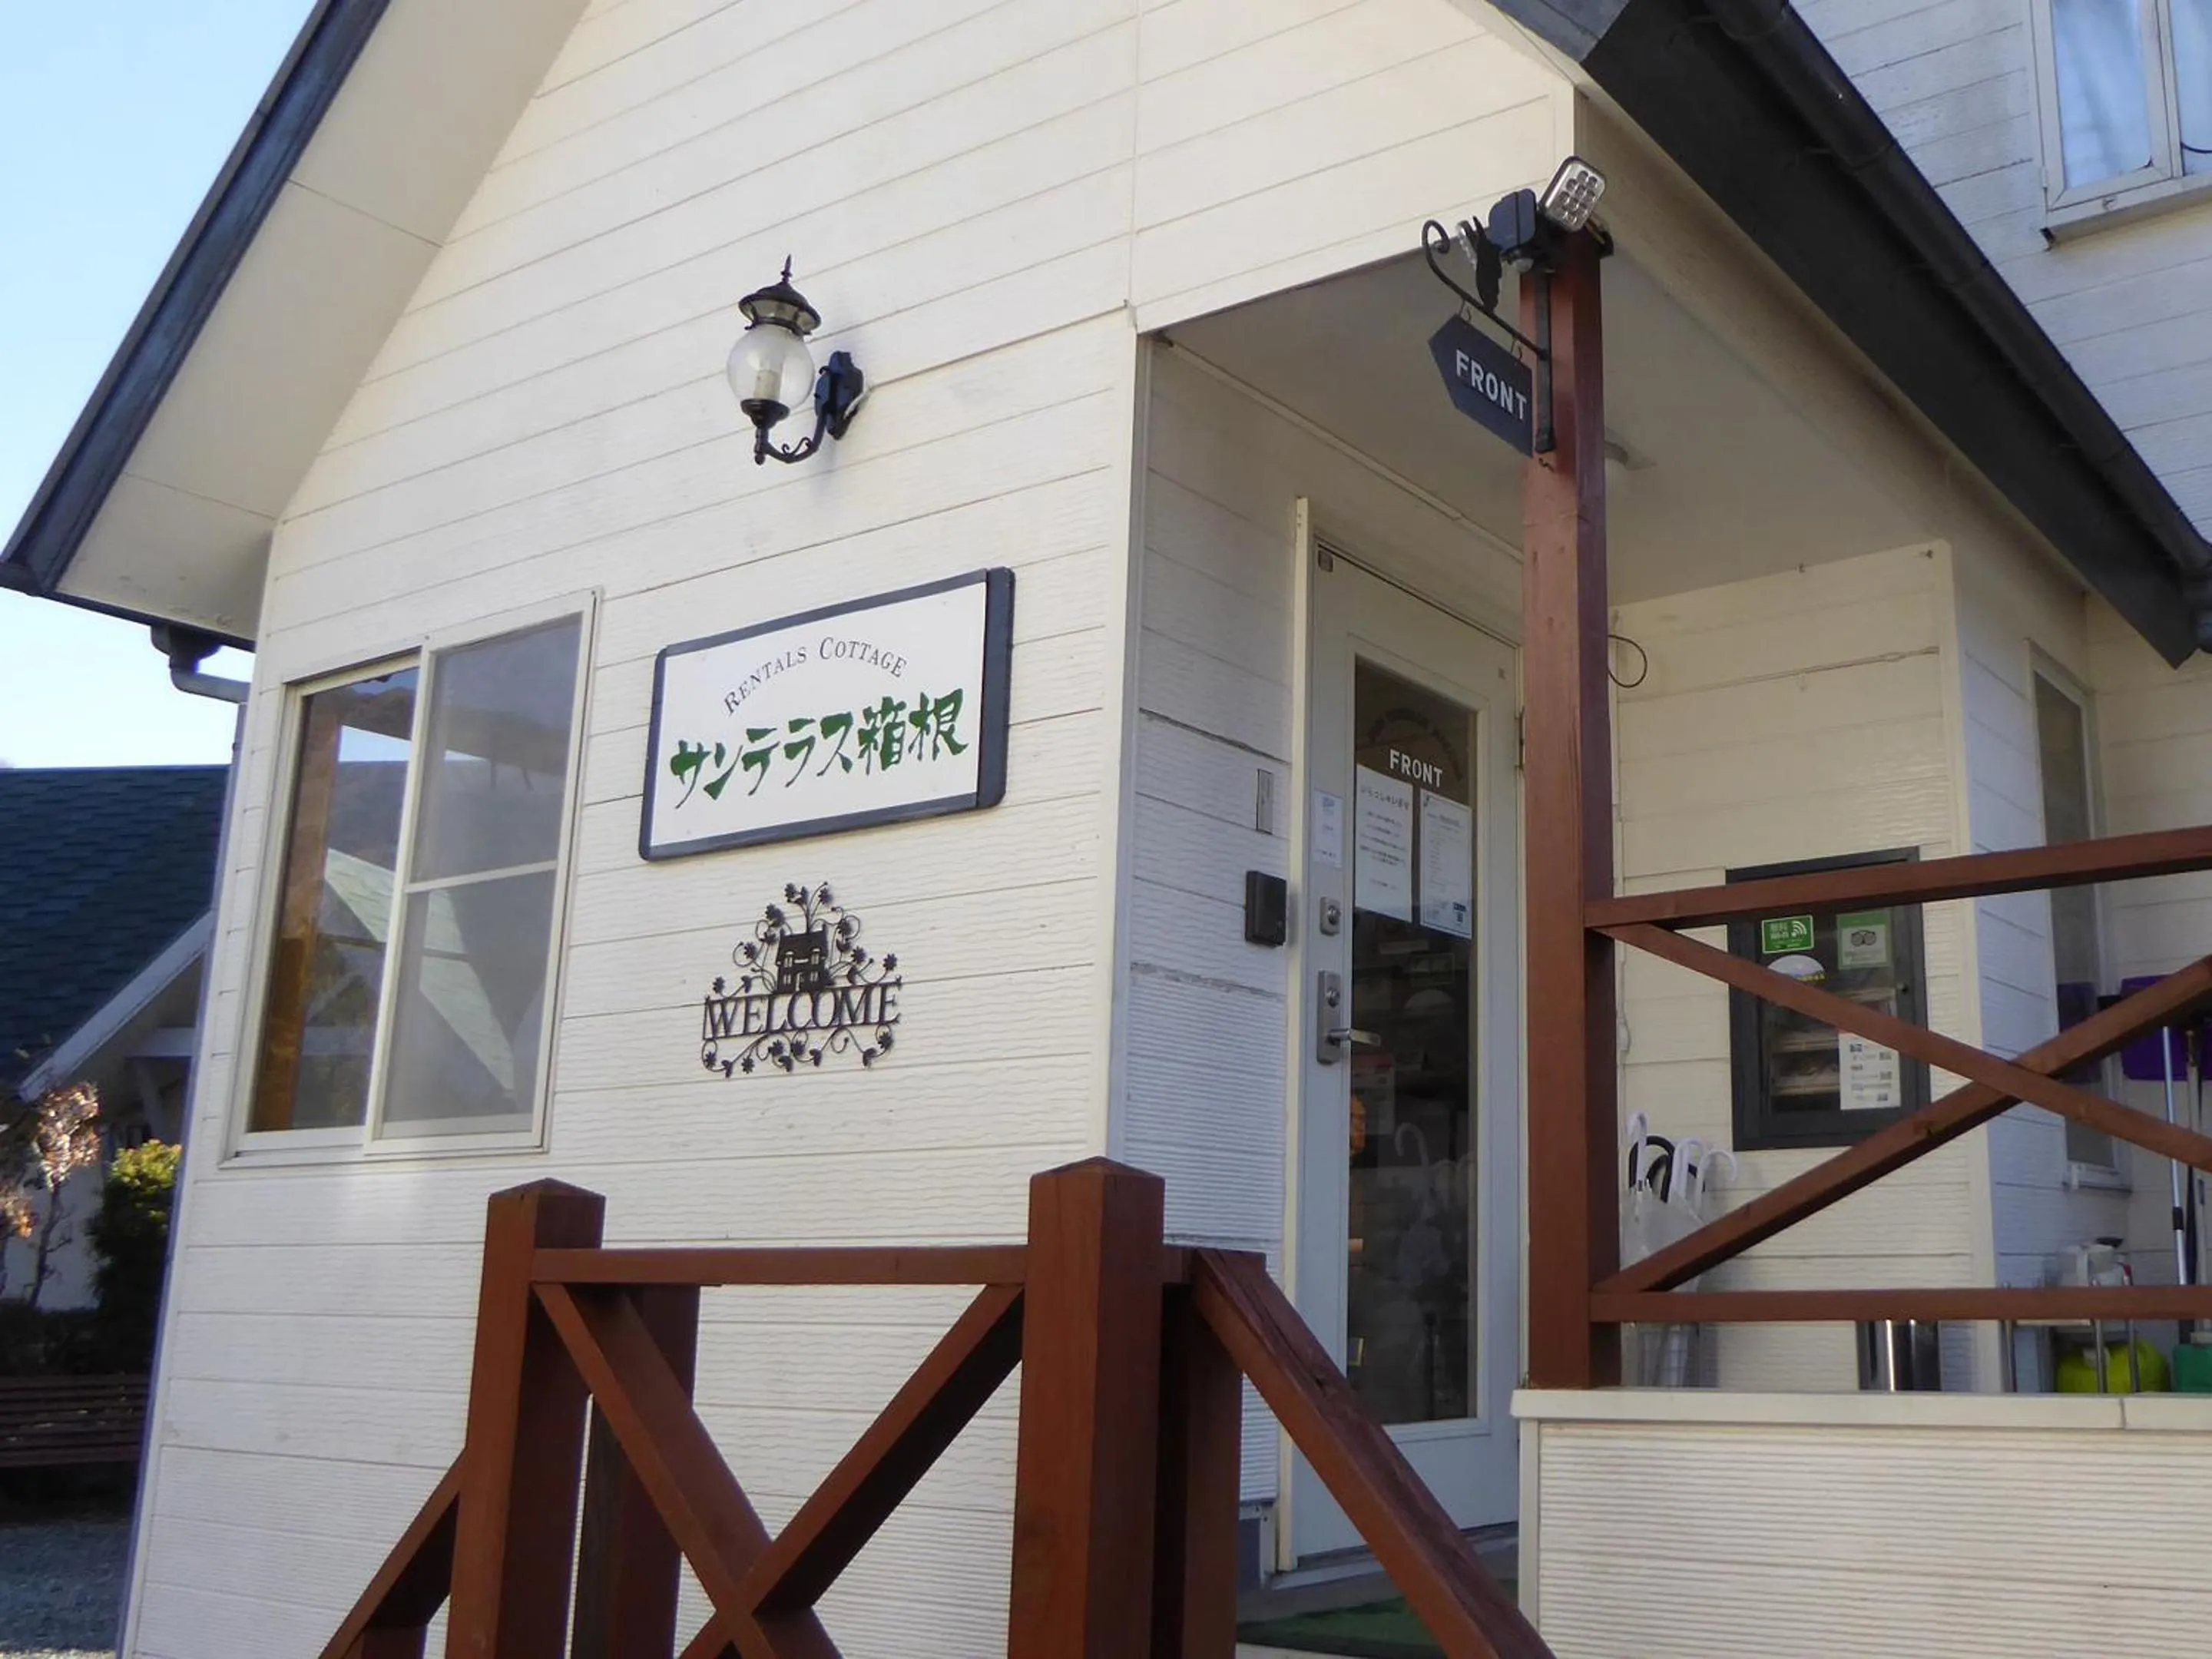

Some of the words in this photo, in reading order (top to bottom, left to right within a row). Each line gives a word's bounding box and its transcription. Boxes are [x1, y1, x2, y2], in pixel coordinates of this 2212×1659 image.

[1455, 349, 1527, 420] FRONT
[723, 646, 808, 717] RENTALS
[819, 637, 907, 678] COTTAGE
[670, 688, 969, 809] サンテラス箱根
[1389, 749, 1442, 787] FRONT
[703, 980, 901, 1040] WELCOME
